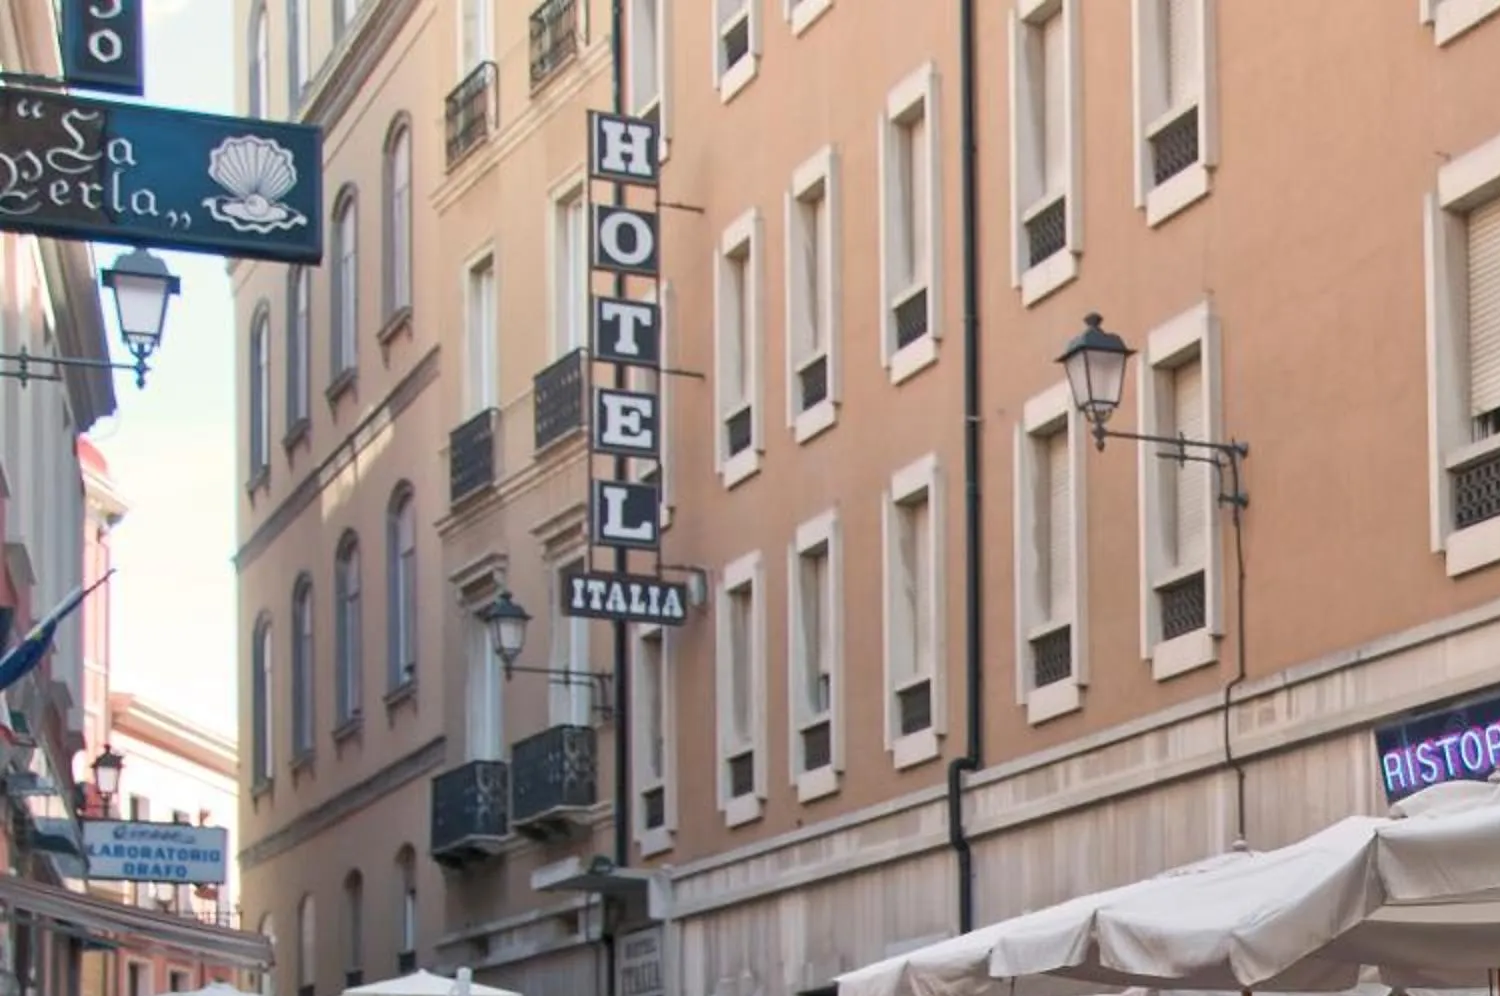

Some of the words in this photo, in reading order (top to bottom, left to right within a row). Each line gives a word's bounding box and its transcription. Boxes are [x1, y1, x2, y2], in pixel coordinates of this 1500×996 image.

[600, 119, 656, 540] HOTEL
[571, 577, 684, 618] ITALIA
[88, 844, 221, 862] LABORATORIO
[123, 862, 188, 878] ORAFO
